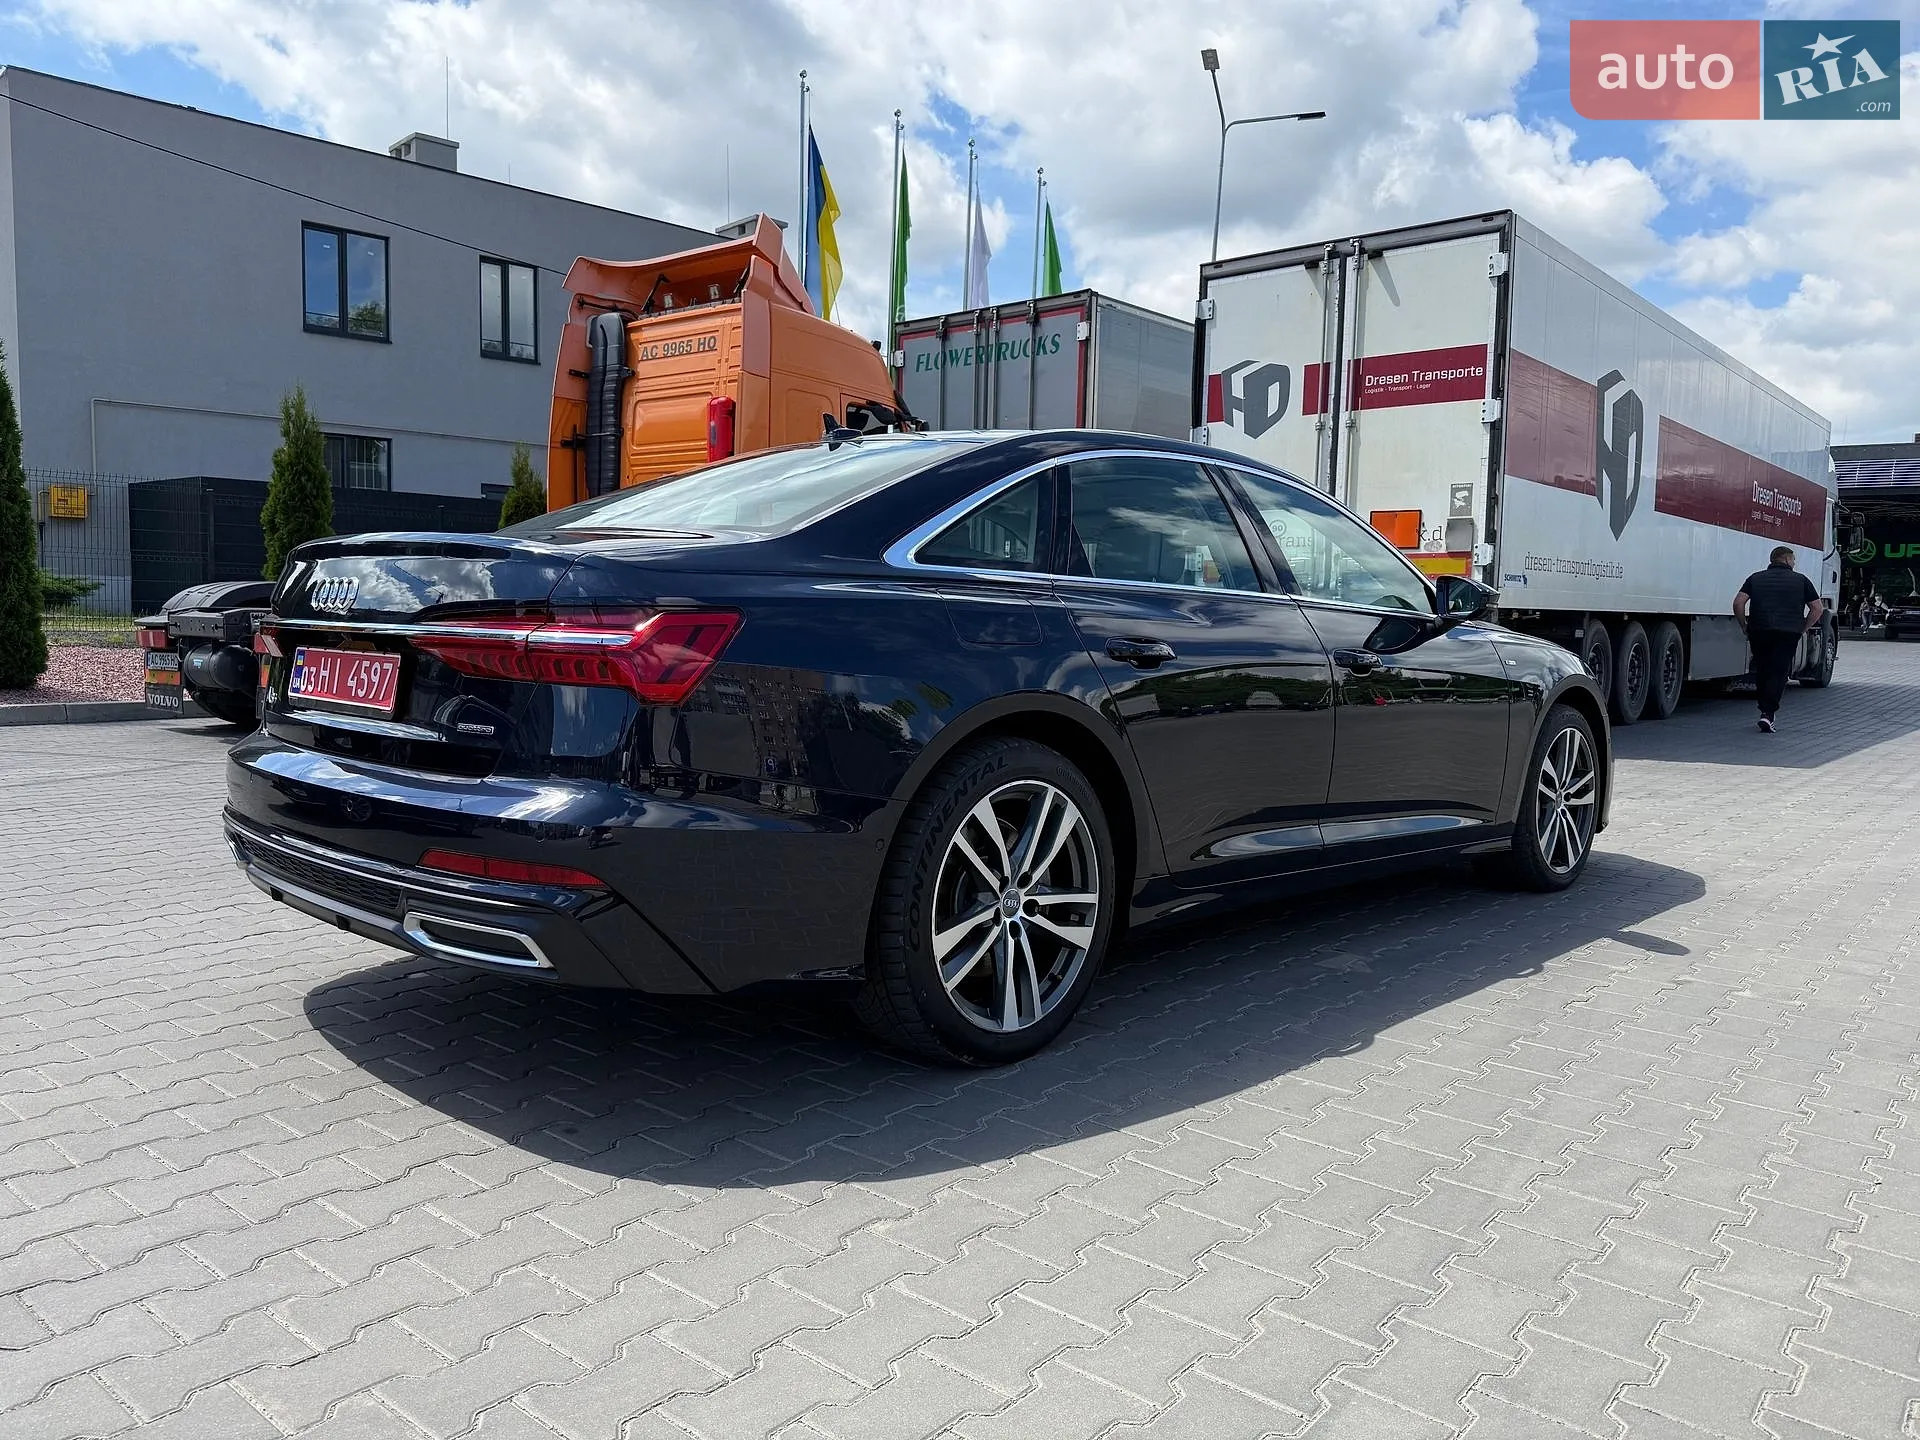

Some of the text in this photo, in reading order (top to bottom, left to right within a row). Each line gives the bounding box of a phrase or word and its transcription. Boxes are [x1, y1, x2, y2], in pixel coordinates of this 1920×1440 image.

[641, 345, 659, 360] AC
[662, 339, 693, 357] 9965
[1365, 365, 1484, 387] Dresen Transporte
[1388, 384, 1412, 392] Transport
[1416, 382, 1432, 390] Lager
[1752, 480, 1802, 517] Dresen Transporte
[1524, 551, 1624, 580] dresen-transportlogistik.de
[346, 660, 394, 701] 4597
[147, 693, 179, 708] VOLVO
[907, 755, 1010, 952] CONTINENTAL
